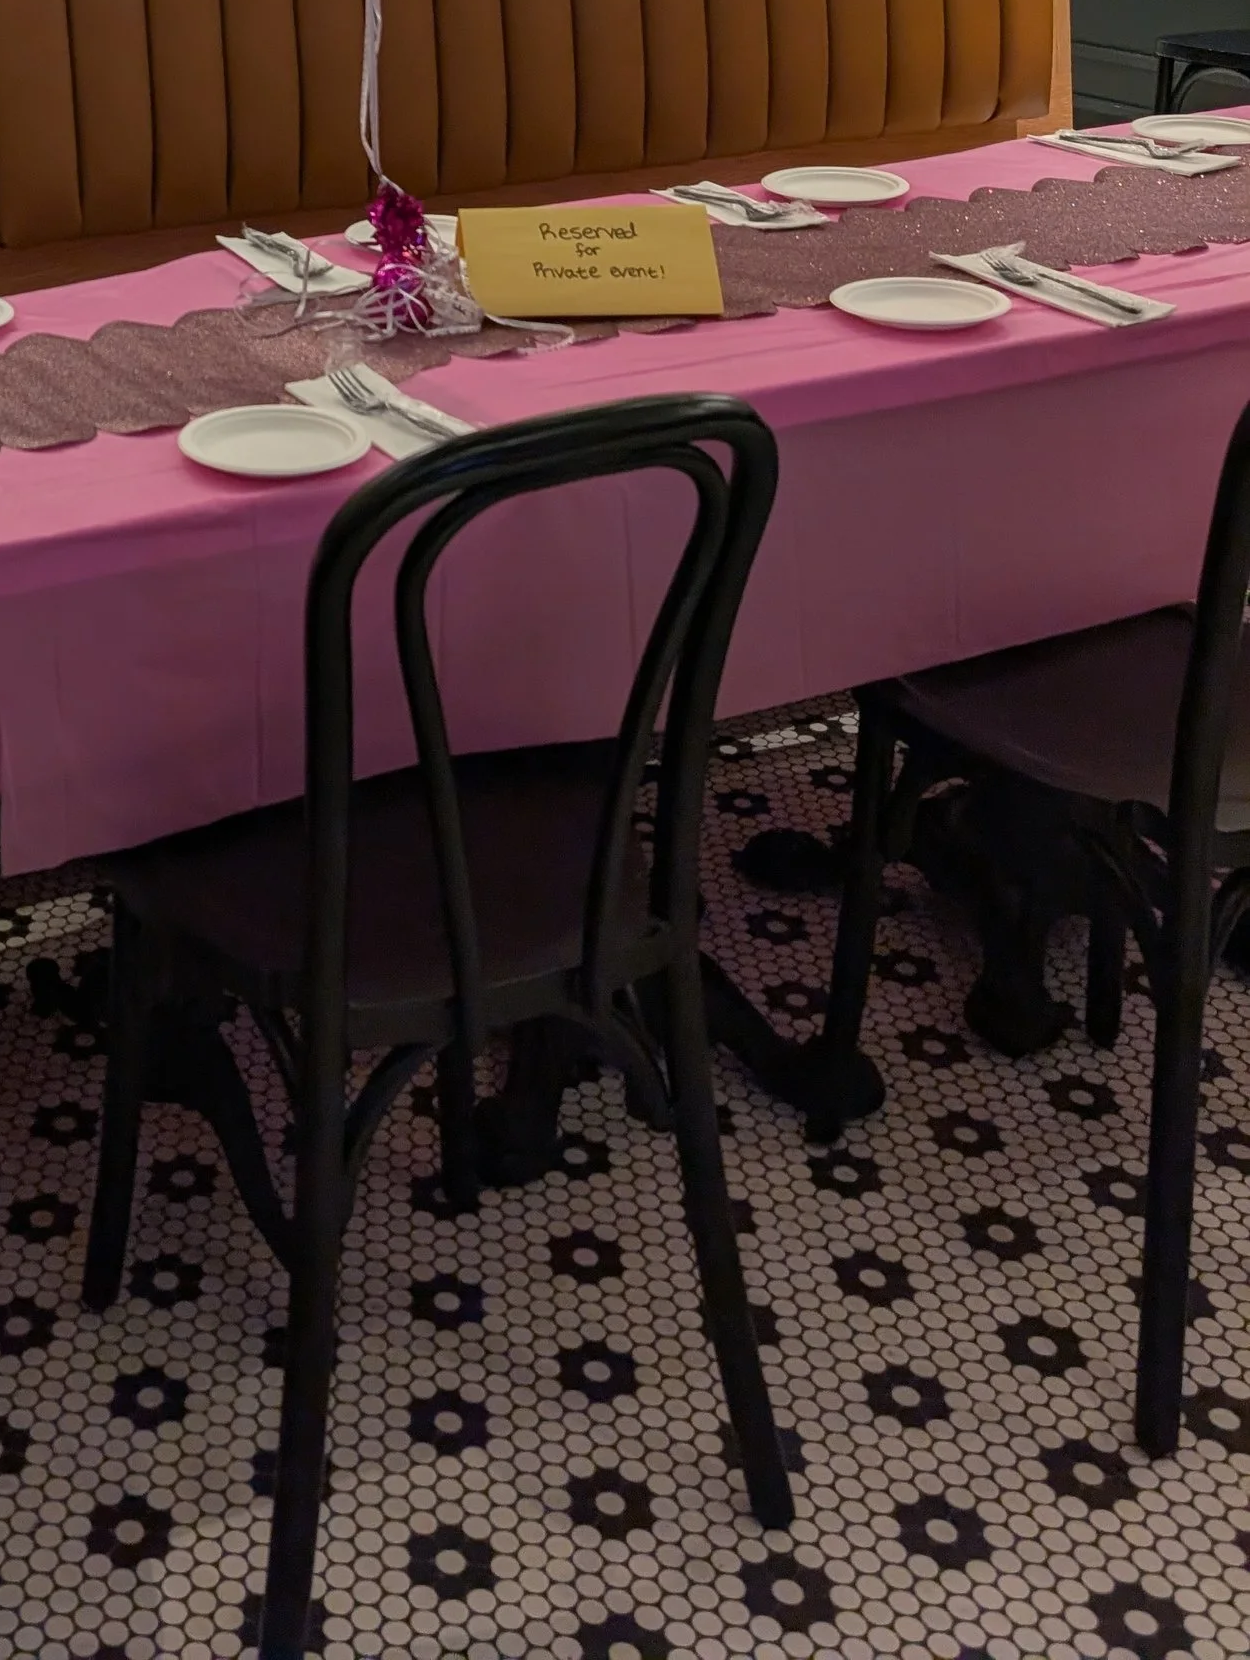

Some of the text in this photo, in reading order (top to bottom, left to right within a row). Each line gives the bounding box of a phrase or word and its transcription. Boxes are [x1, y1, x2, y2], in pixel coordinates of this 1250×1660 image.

[538, 221, 638, 241] Reserved
[575, 242, 601, 258] for
[532, 261, 666, 280] Private event!
